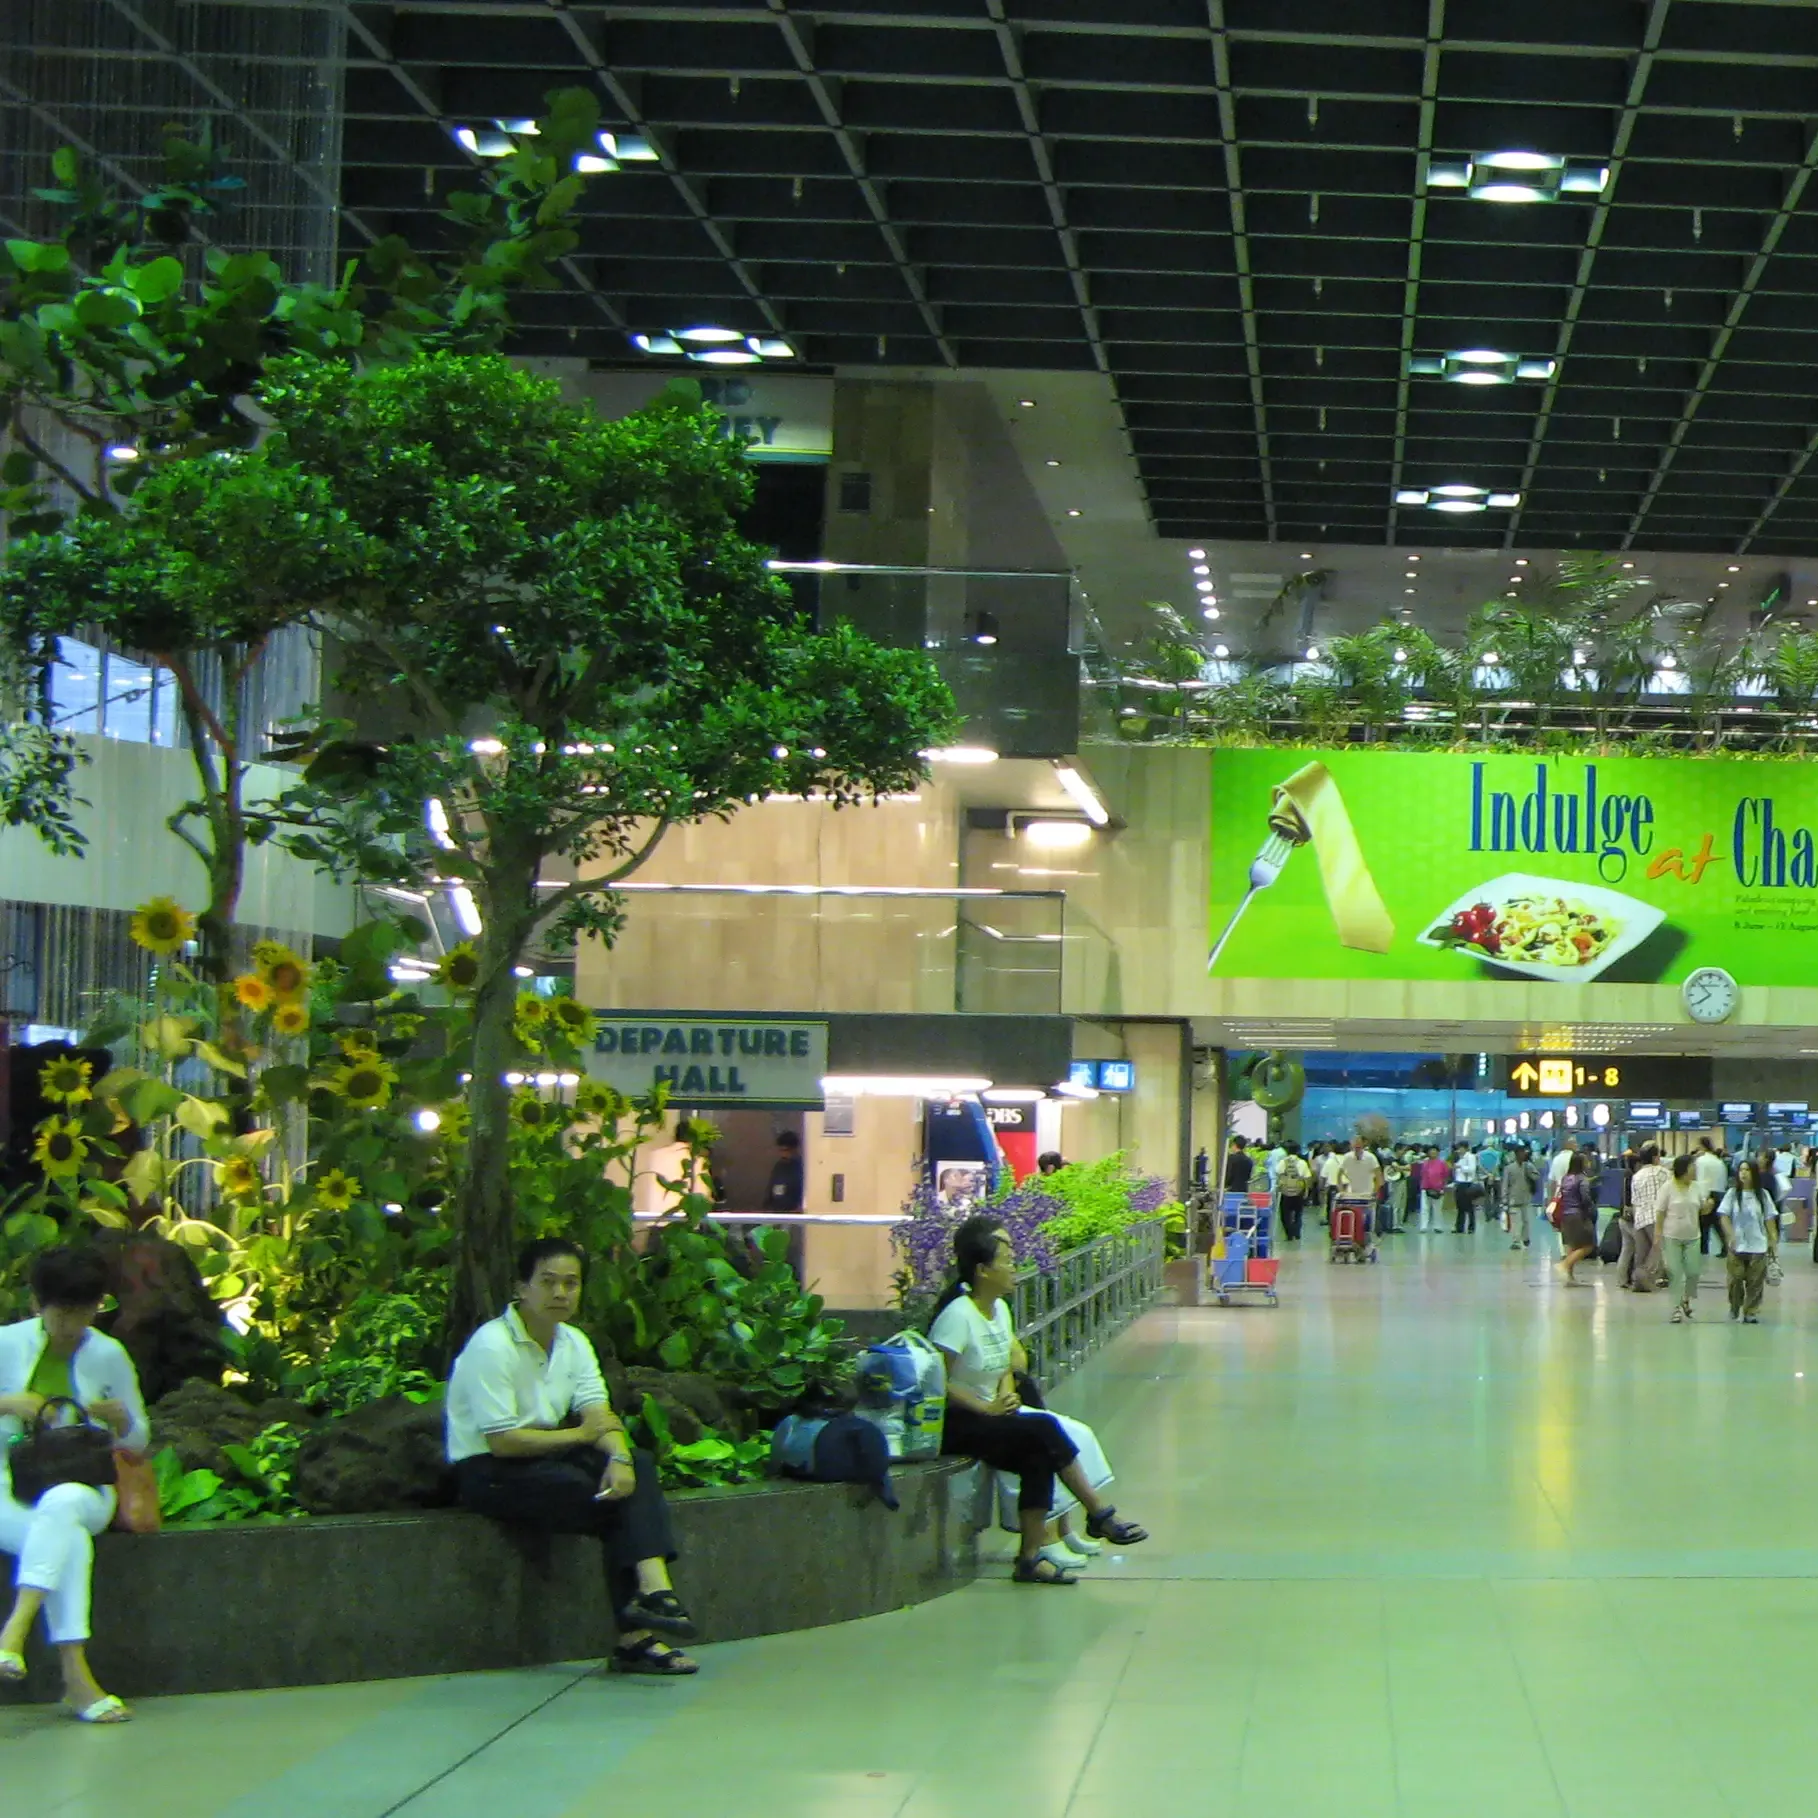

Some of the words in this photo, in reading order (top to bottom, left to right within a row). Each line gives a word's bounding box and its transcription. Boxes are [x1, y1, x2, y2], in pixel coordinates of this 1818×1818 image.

[1467, 762, 1654, 883] Indulge
[1646, 833, 1726, 884] at
[595, 1026, 809, 1057] DEPARTURE
[654, 1064, 748, 1094] HALL
